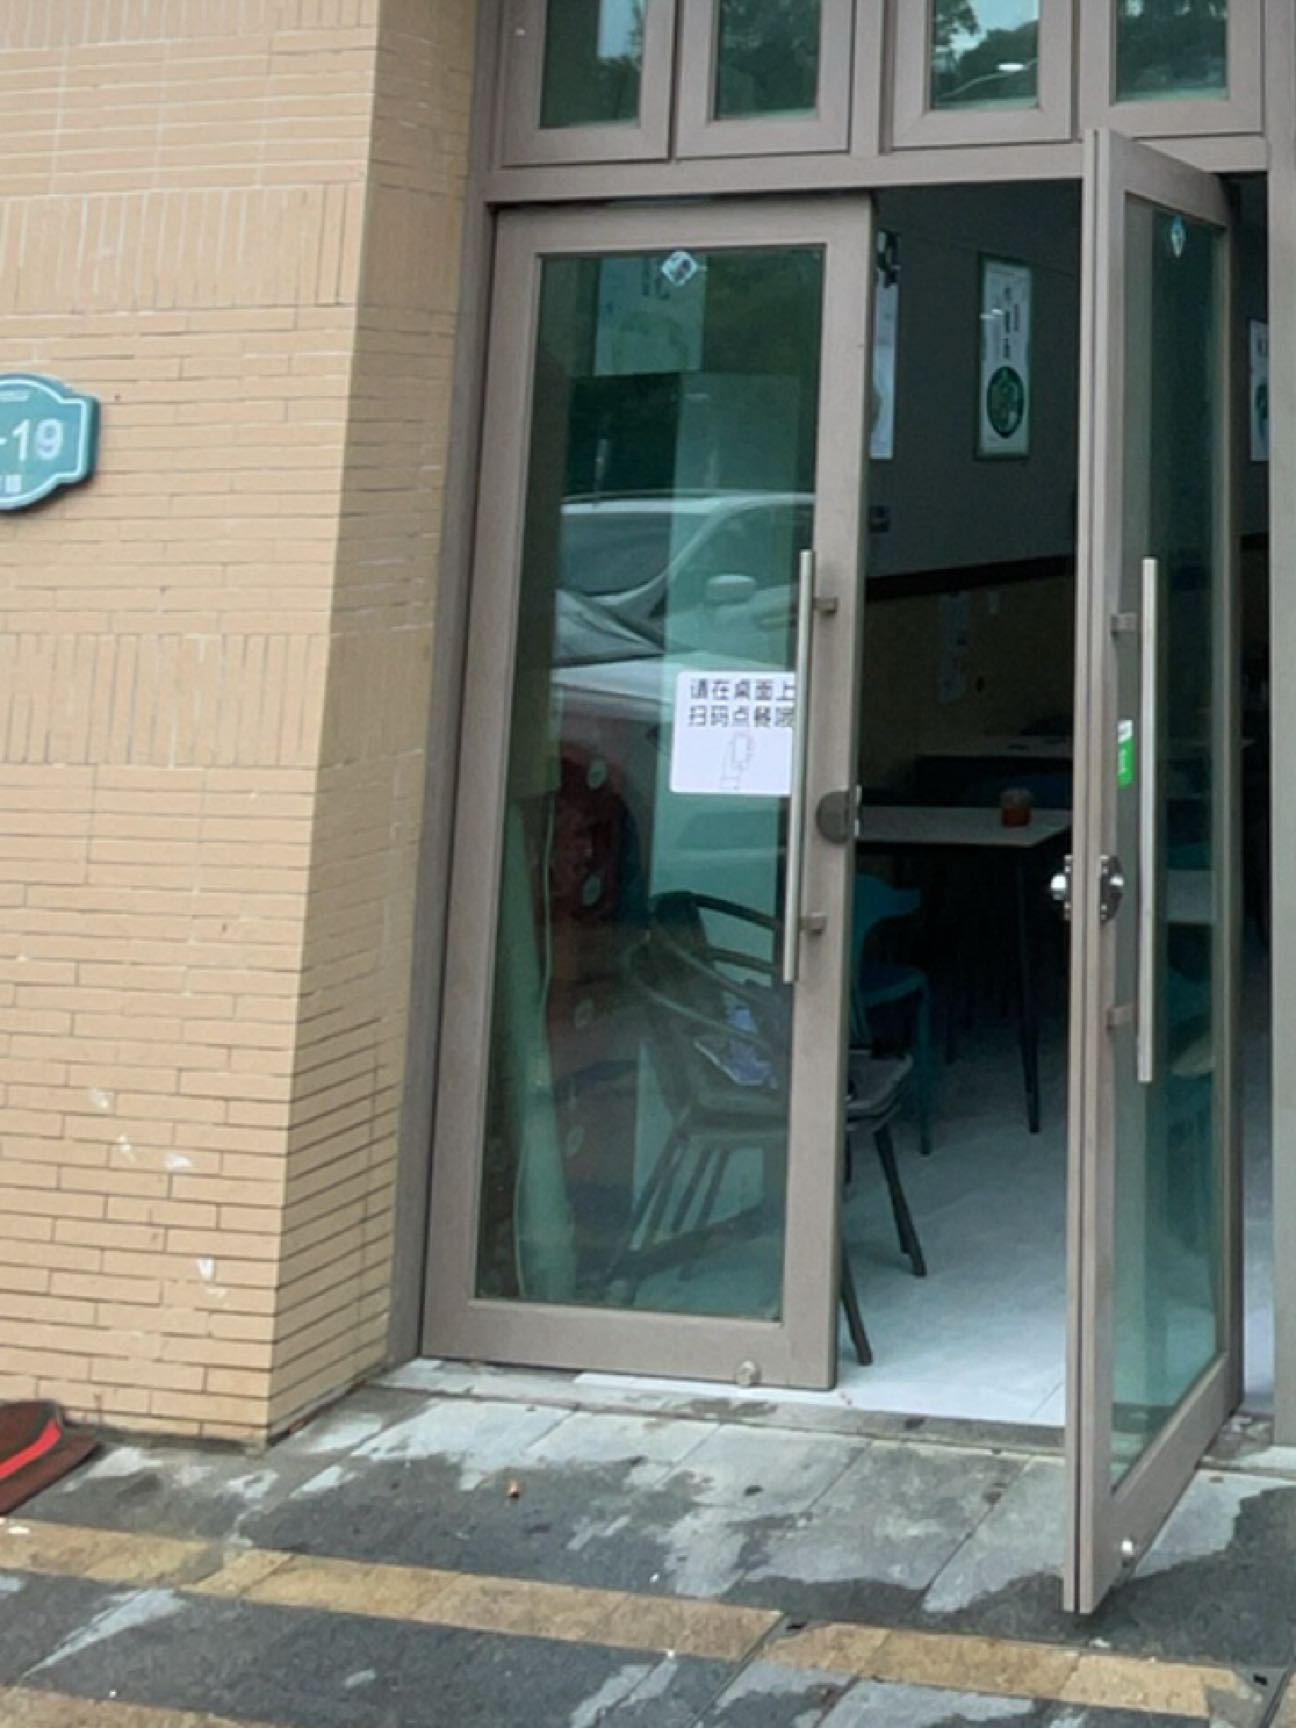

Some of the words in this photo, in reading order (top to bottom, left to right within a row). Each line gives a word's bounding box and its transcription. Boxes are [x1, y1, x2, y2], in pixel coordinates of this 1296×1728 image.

[0, 418, 64, 462] 19
[690, 677, 796, 701] 请在桌面上
